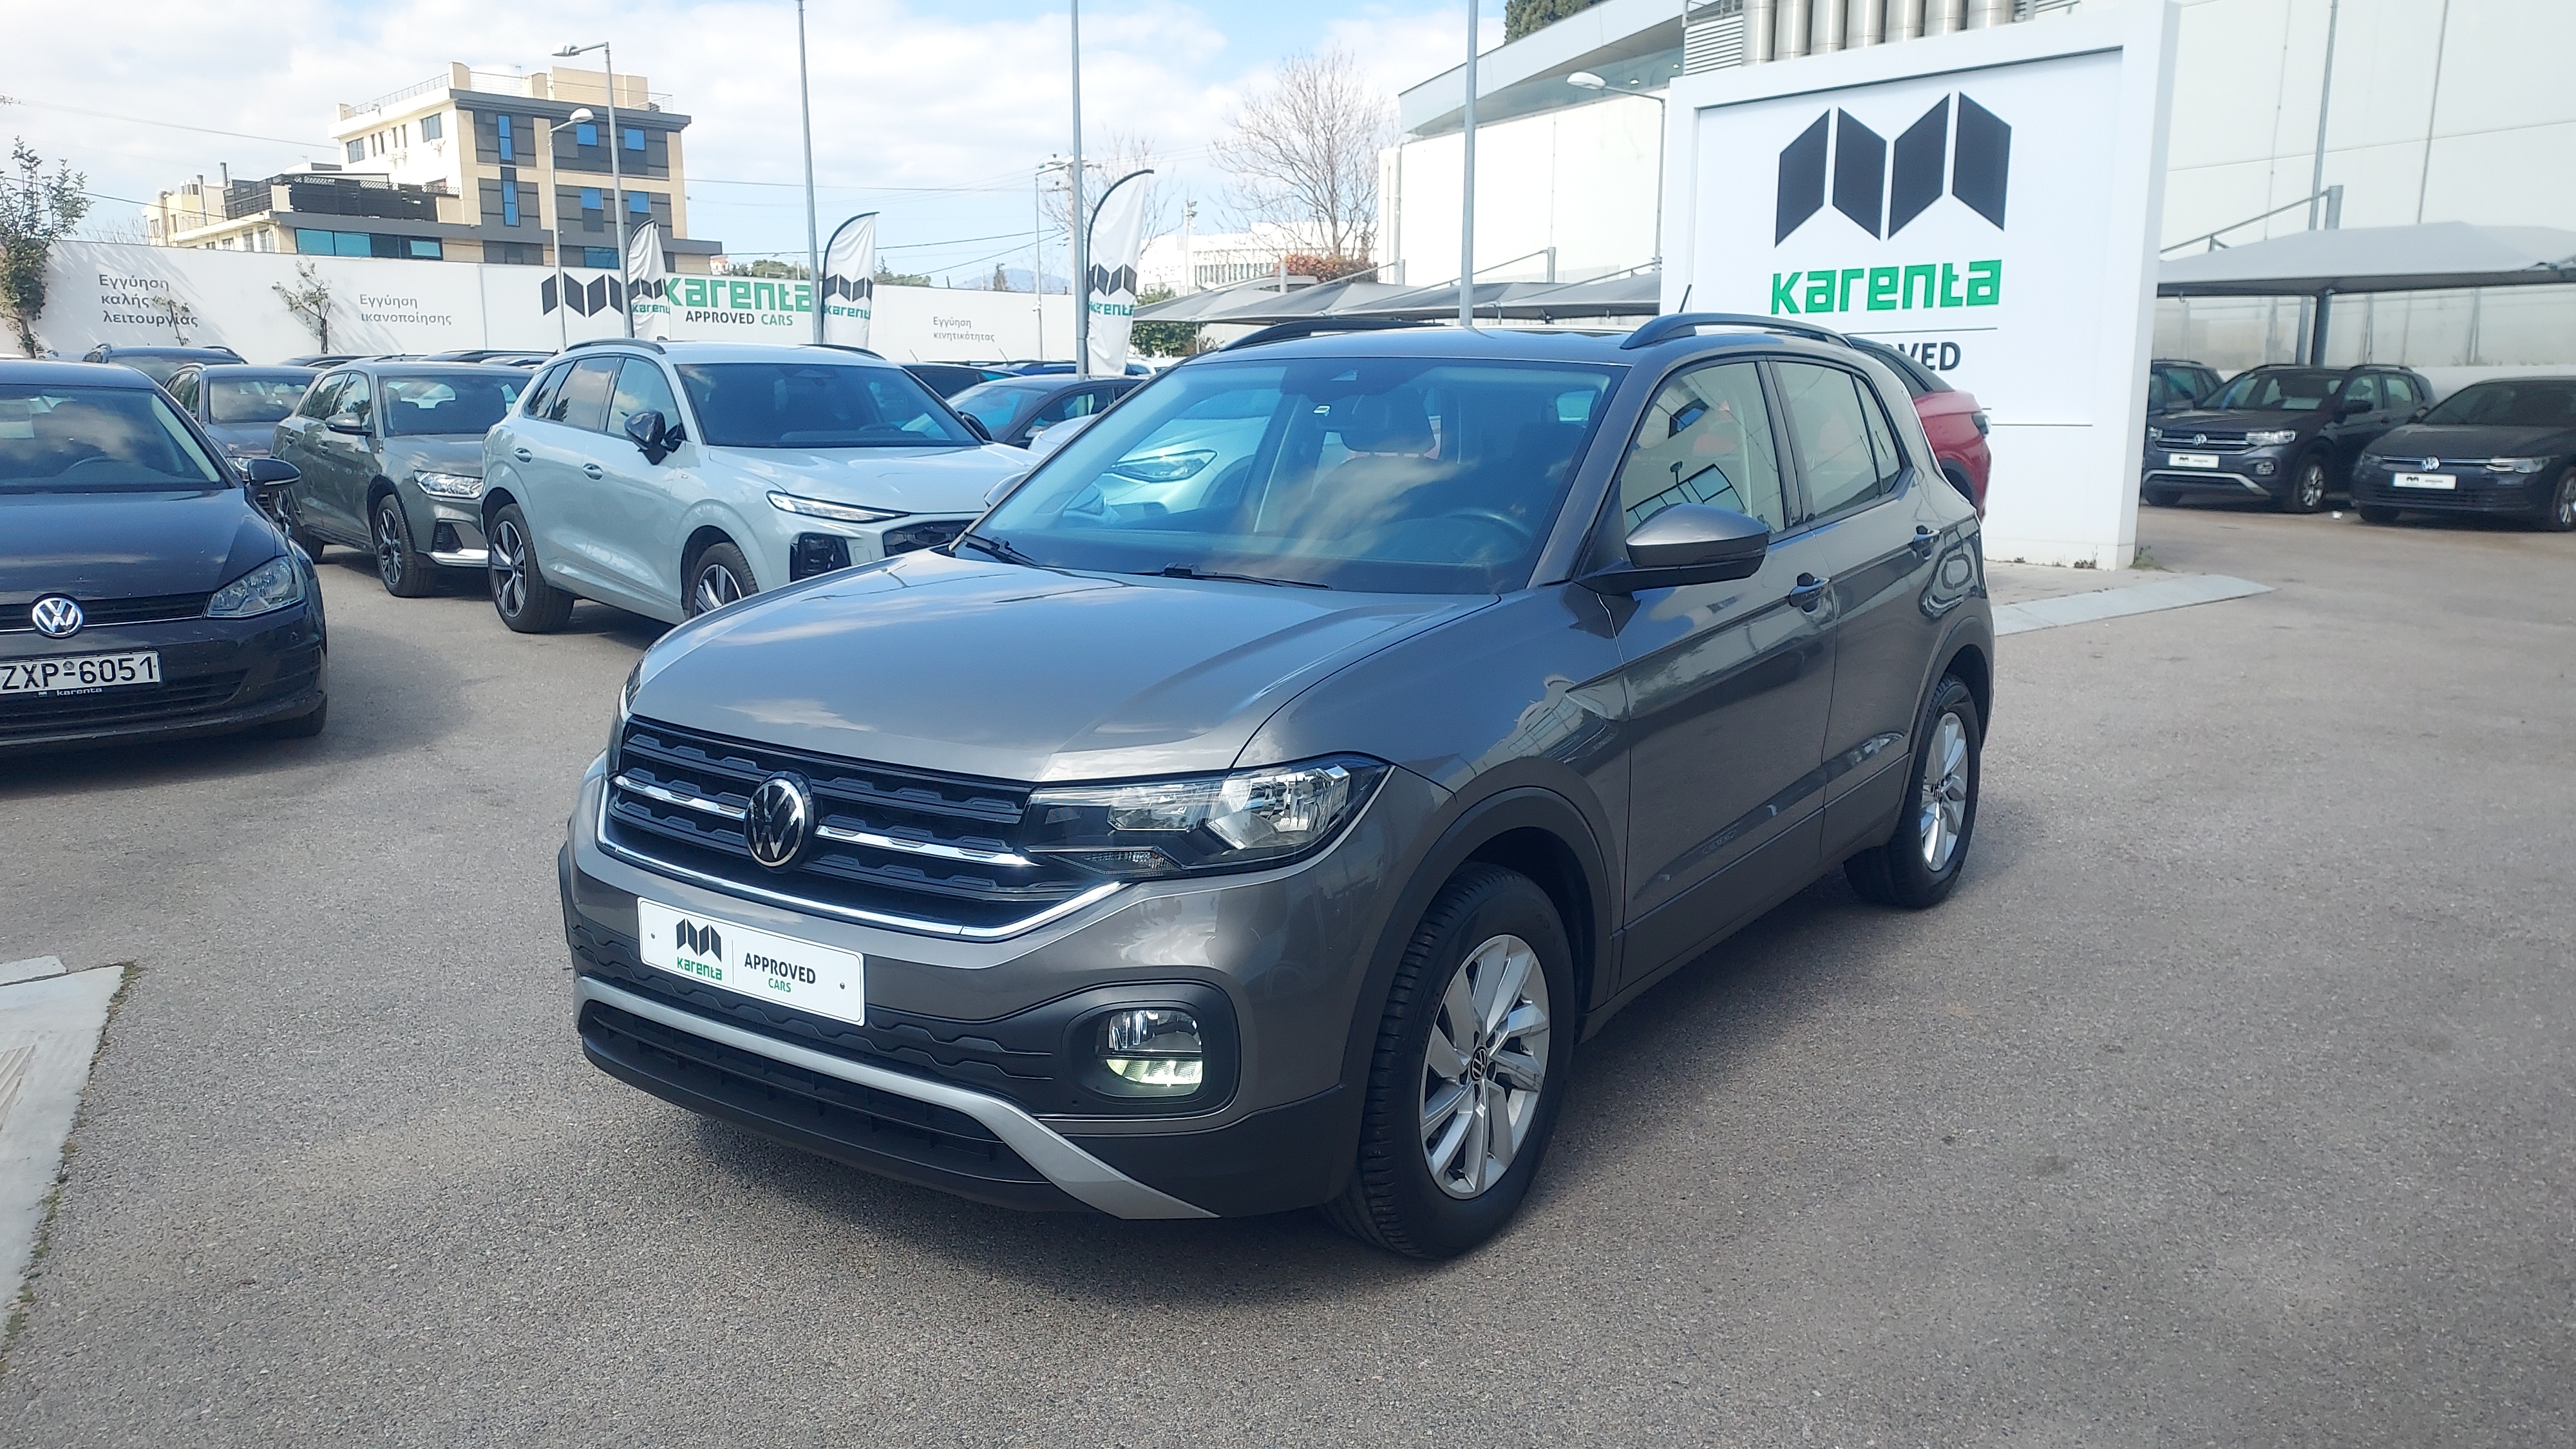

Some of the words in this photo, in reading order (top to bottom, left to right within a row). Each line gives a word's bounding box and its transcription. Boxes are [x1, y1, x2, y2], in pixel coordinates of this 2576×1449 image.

[99, 274, 169, 292] Εγγύηση
[101, 293, 149, 308] καλής
[359, 294, 418, 309] Εγγύηση
[103, 310, 198, 328] λειτουργίας
[361, 312, 452, 326] ικανοποίησης
[685, 310, 755, 325] APPROVED
[761, 314, 793, 327] CARS
[933, 316, 972, 329] Εγγύηση
[934, 330, 995, 343] κινητικότητας
[32, 596, 84, 639] VW
[749, 778, 805, 867] VW
[744, 952, 816, 985] APPROVED
[768, 978, 791, 993] CARS
